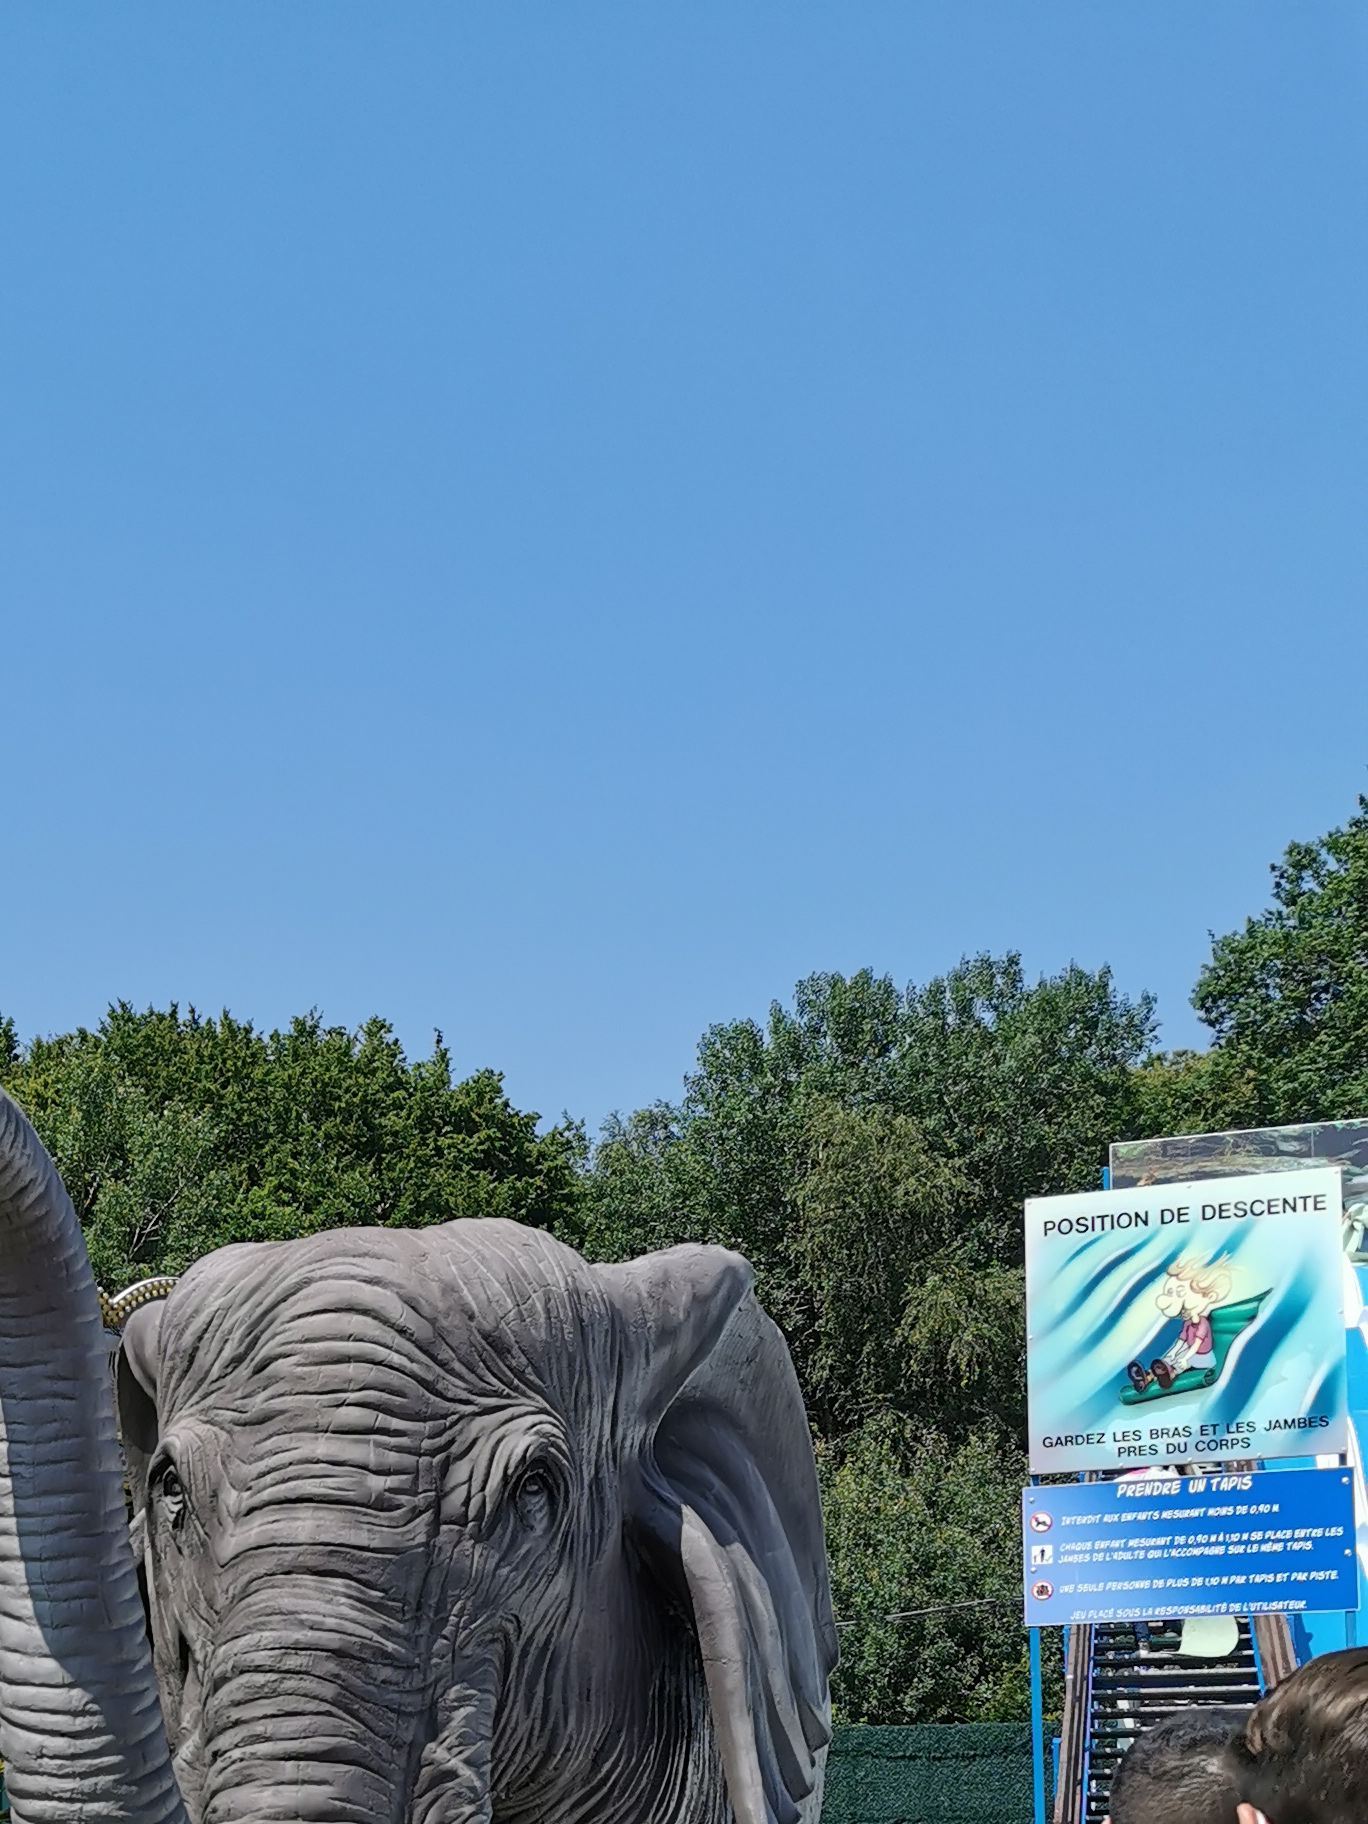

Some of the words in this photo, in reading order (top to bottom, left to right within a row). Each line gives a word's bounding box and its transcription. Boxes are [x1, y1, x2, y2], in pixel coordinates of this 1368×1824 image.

[1043, 1210, 1149, 1236] POSITION
[1160, 1206, 1190, 1225] DE
[1201, 1194, 1327, 1221] DESCENTE
[1042, 1432, 1105, 1449] GARDEZ
[1112, 1429, 1142, 1443] LES
[1149, 1425, 1192, 1440] BRAS
[1200, 1423, 1220, 1436] ET
[1226, 1421, 1256, 1434] LES
[1264, 1415, 1329, 1432] JAMBES
[1117, 1444, 1158, 1458] PRES
[1166, 1442, 1187, 1455] DU
[1194, 1437, 1251, 1452] CORPS
[1116, 1480, 1181, 1499] PRENDRE
[1188, 1478, 1206, 1494] UN
[1210, 1475, 1253, 1492] TAPIS
[1061, 1514, 1101, 1526] INTERDIT
[1103, 1513, 1120, 1523] AUX
[1121, 1510, 1160, 1522] ENFANTS
[1161, 1508, 1206, 1520] MESURANT
[1207, 1506, 1234, 1517] MOINS
[1236, 1505, 1248, 1515] DE
[1250, 1504, 1271, 1515] 0,90
[1059, 1541, 1092, 1552] CHAQUE
[1094, 1539, 1127, 1550] ENFANT
[1127, 1536, 1173, 1548] MESURANT
[1174, 1535, 1186, 1545] DE
[1187, 1534, 1208, 1545] 0,90
[1209, 1534, 1217, 1543] M
[1241, 1532, 1249, 1541] M
[1250, 1531, 1263, 1541] SE
[1265, 1530, 1293, 1540] PLACE
[1294, 1528, 1324, 1539] ENTRE
[1325, 1526, 1344, 1537] LES
[1058, 1553, 1090, 1564] JAMBES
[1093, 1552, 1104, 1562] DE
[1105, 1550, 1145, 1561] L'ADULTE
[1147, 1549, 1162, 1559] QUI
[1163, 1545, 1226, 1558] L'ACCOMPAGNE
[1227, 1545, 1245, 1554] SUR
[1246, 1543, 1259, 1553] LE
[1260, 1540, 1284, 1552] MÊME
[1286, 1540, 1314, 1551] TAPIS.
[1059, 1584, 1075, 1594] UNE
[1077, 1582, 1104, 1593] SEULE
[1105, 1579, 1151, 1591] PERSONNE
[1152, 1579, 1164, 1589] DE
[1166, 1577, 1189, 1587] PLUS
[1191, 1577, 1203, 1586] DE
[1220, 1576, 1229, 1585] M
[1229, 1575, 1247, 1585] PAR
[1248, 1573, 1275, 1584] TAPIS
[1276, 1572, 1290, 1582] ET
[1290, 1572, 1309, 1581] PAR
[1309, 1570, 1339, 1580] PISTE.
[1070, 1610, 1087, 1620] JEU
[1087, 1607, 1114, 1619] PLACÉ
[1116, 1607, 1141, 1618] SOUS
[1142, 1607, 1153, 1616] LA
[1154, 1602, 1227, 1616] RESPONSABILITÉ
[1229, 1602, 1241, 1613] DE
[1243, 1600, 1307, 1612] L'UTILISATEUR.
